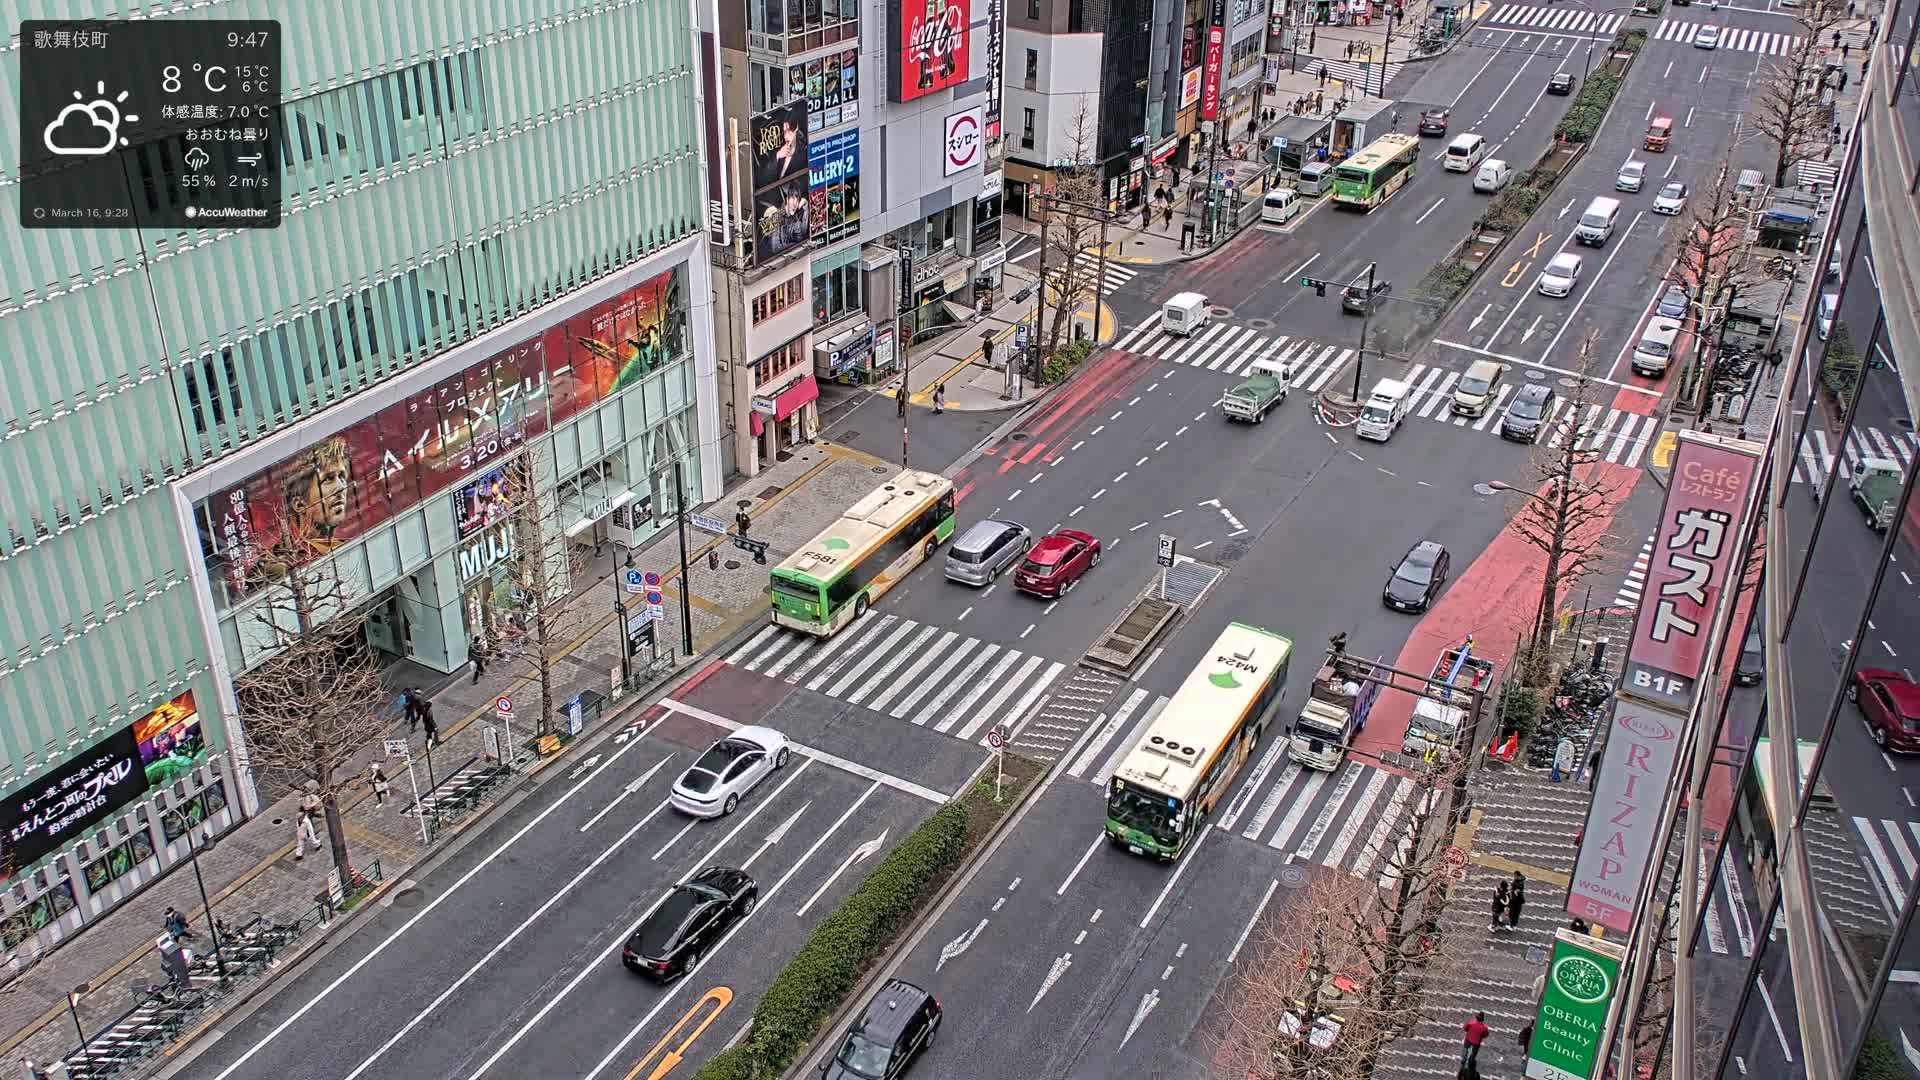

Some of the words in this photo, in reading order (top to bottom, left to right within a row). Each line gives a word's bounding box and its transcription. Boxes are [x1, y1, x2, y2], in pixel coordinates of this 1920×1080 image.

[909, 5, 963, 63] Coca-Cola
[1206, 45, 1220, 111] バーガーキング
[825, 88, 854, 106] HALL
[948, 134, 979, 152] スシロー
[710, 199, 723, 233] MUJI
[830, 352, 840, 366] P
[409, 341, 542, 412] ライアン・ゴズリング
[446, 377, 504, 413] プロジェクト
[459, 439, 499, 470] 3.20
[1682, 461, 1741, 490] Café
[1680, 479, 1736, 502] レストラン
[460, 522, 516, 581] MUJI
[1161, 540, 1169, 549] P
[801, 551, 836, 565] F581
[1651, 507, 1731, 643] ガスト
[1217, 656, 1258, 673] M424
[1633, 670, 1683, 696] B1F
[1597, 743, 1653, 881] RIZAP
[1579, 879, 1632, 905] WOMAN
[1584, 901, 1618, 921] 5F
[1560, 970, 1601, 991] OBERIA
[1543, 1005, 1597, 1032] OBERIA
[1543, 1021, 1590, 1046] Beauty
[1542, 1040, 1584, 1061] Clinic
